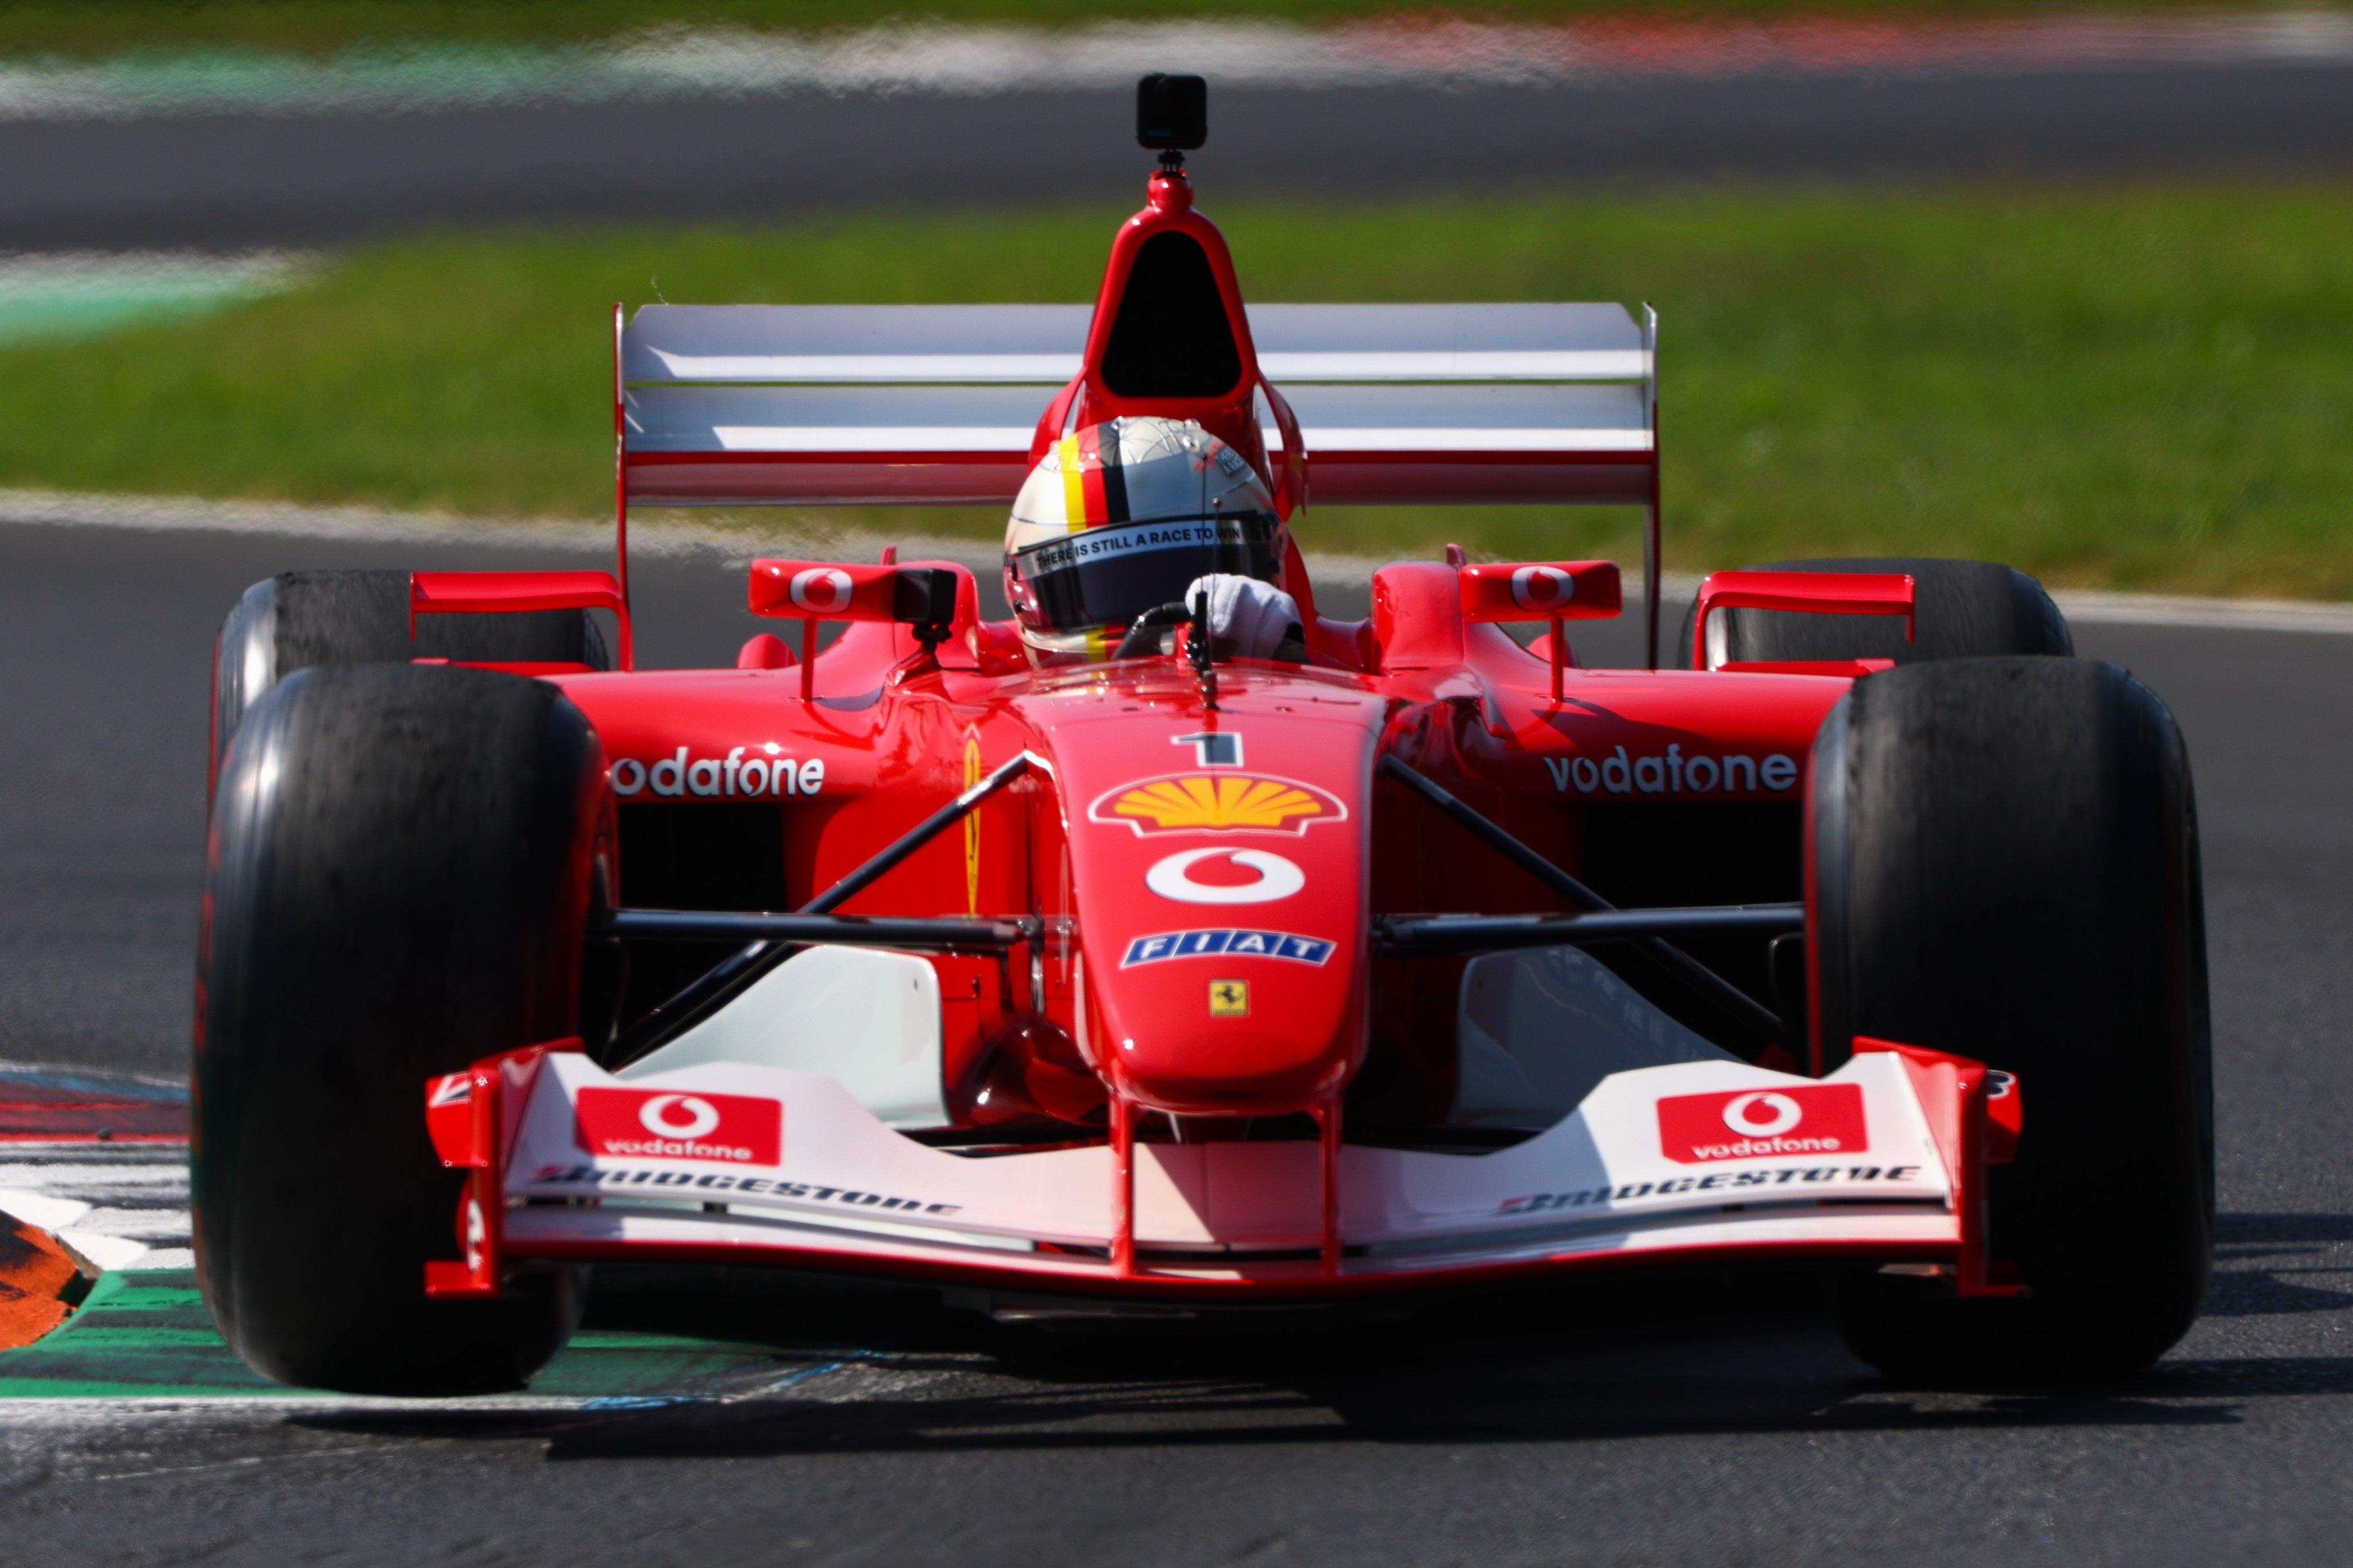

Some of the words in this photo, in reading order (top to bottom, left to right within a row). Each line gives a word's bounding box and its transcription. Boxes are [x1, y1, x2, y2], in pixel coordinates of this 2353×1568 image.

[1036, 546, 1073, 569] THERE
[1075, 544, 1089, 557] IS
[1090, 536, 1132, 554] STILL
[1136, 534, 1147, 546] A
[1150, 528, 1192, 544] RACE
[1194, 527, 1213, 540] TO
[1216, 528, 1240, 539] WIN
[1171, 732, 1244, 767] 1
[1544, 743, 1798, 794] vodafone
[610, 746, 826, 797] odafone
[1139, 932, 1319, 959] FIAT
[603, 1138, 754, 1161] vodafone
[1691, 1136, 1841, 1161] vodafone
[530, 1165, 963, 1216] BRIDGESTONE
[1495, 1165, 1920, 1216] BRIDGESTONE
